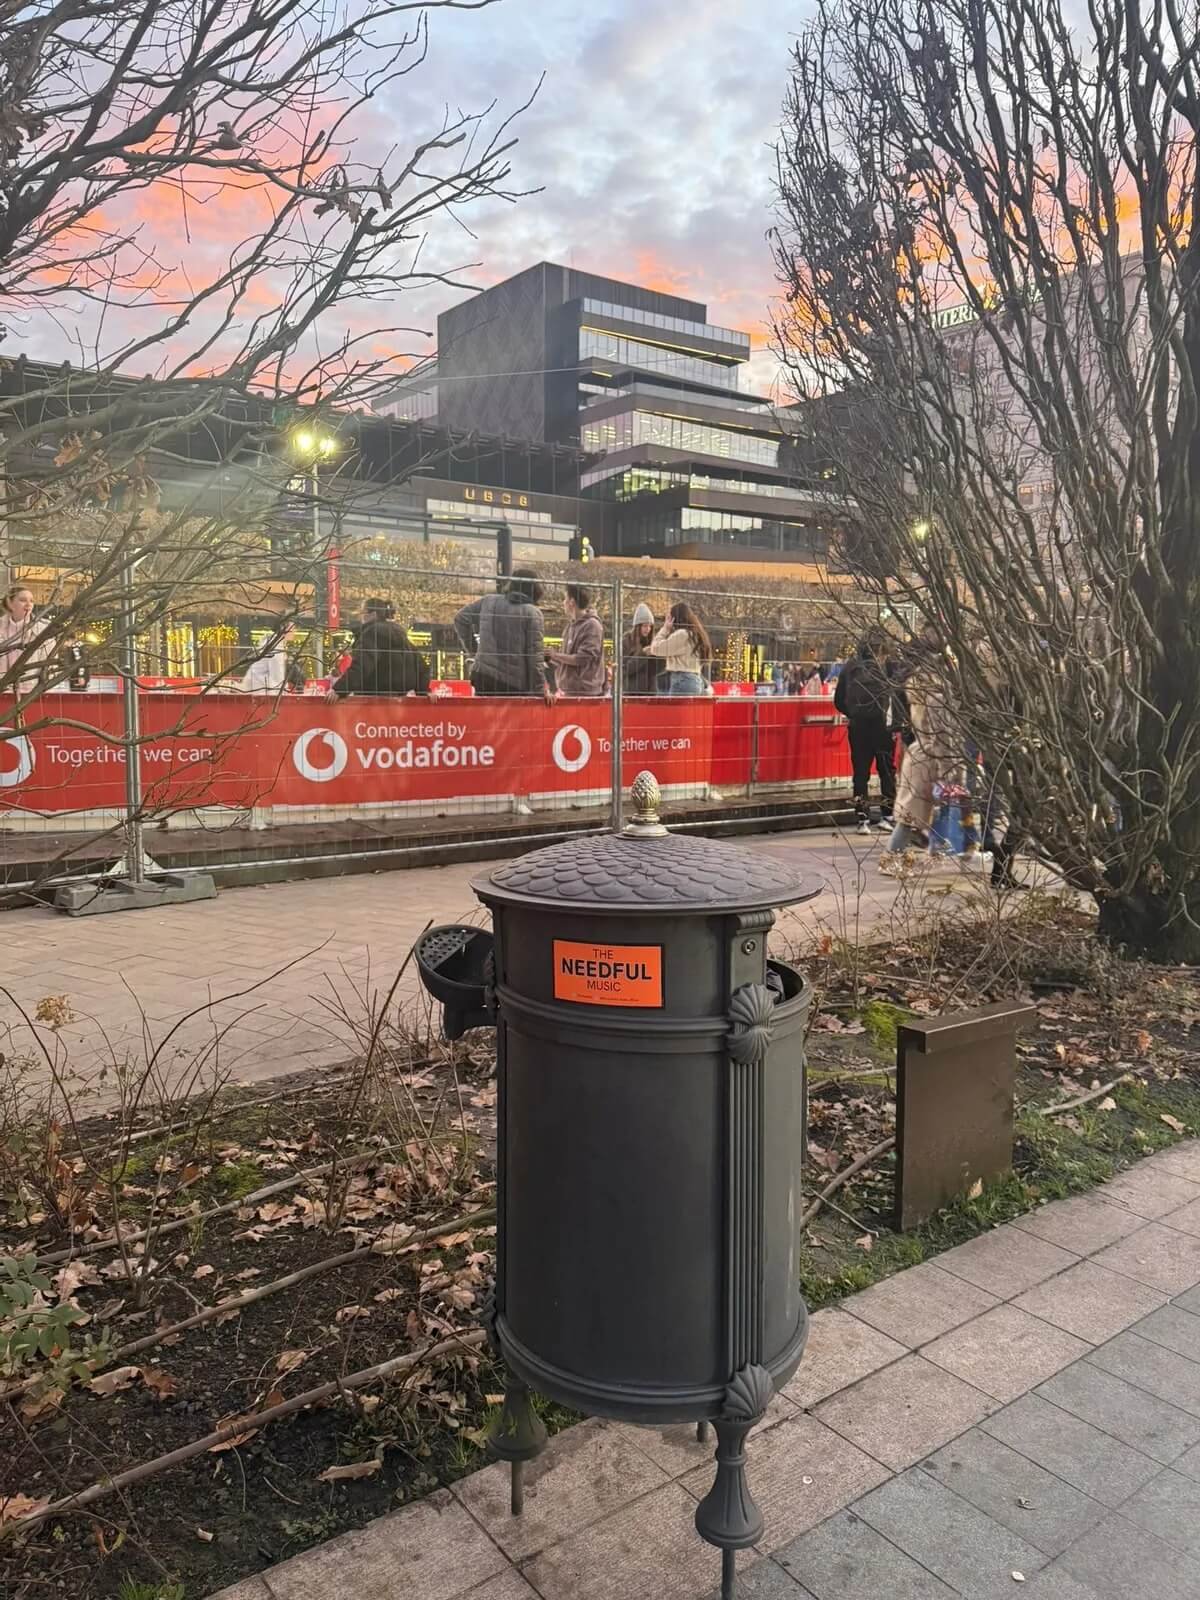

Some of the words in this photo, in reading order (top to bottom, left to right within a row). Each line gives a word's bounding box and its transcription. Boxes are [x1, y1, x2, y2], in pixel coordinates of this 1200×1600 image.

[354, 721, 444, 739] Connected
[447, 721, 467, 741] by
[355, 740, 496, 769] vodafone
[597, 736, 650, 753] Toether
[652, 740, 669, 750] we
[671, 738, 691, 749] can
[46, 744, 128, 768] Togethe
[144, 750, 172, 763] we
[177, 747, 212, 763] can
[592, 948, 614, 959] THE
[562, 958, 652, 980] NEEDFUL
[587, 980, 621, 992] MUSIC
